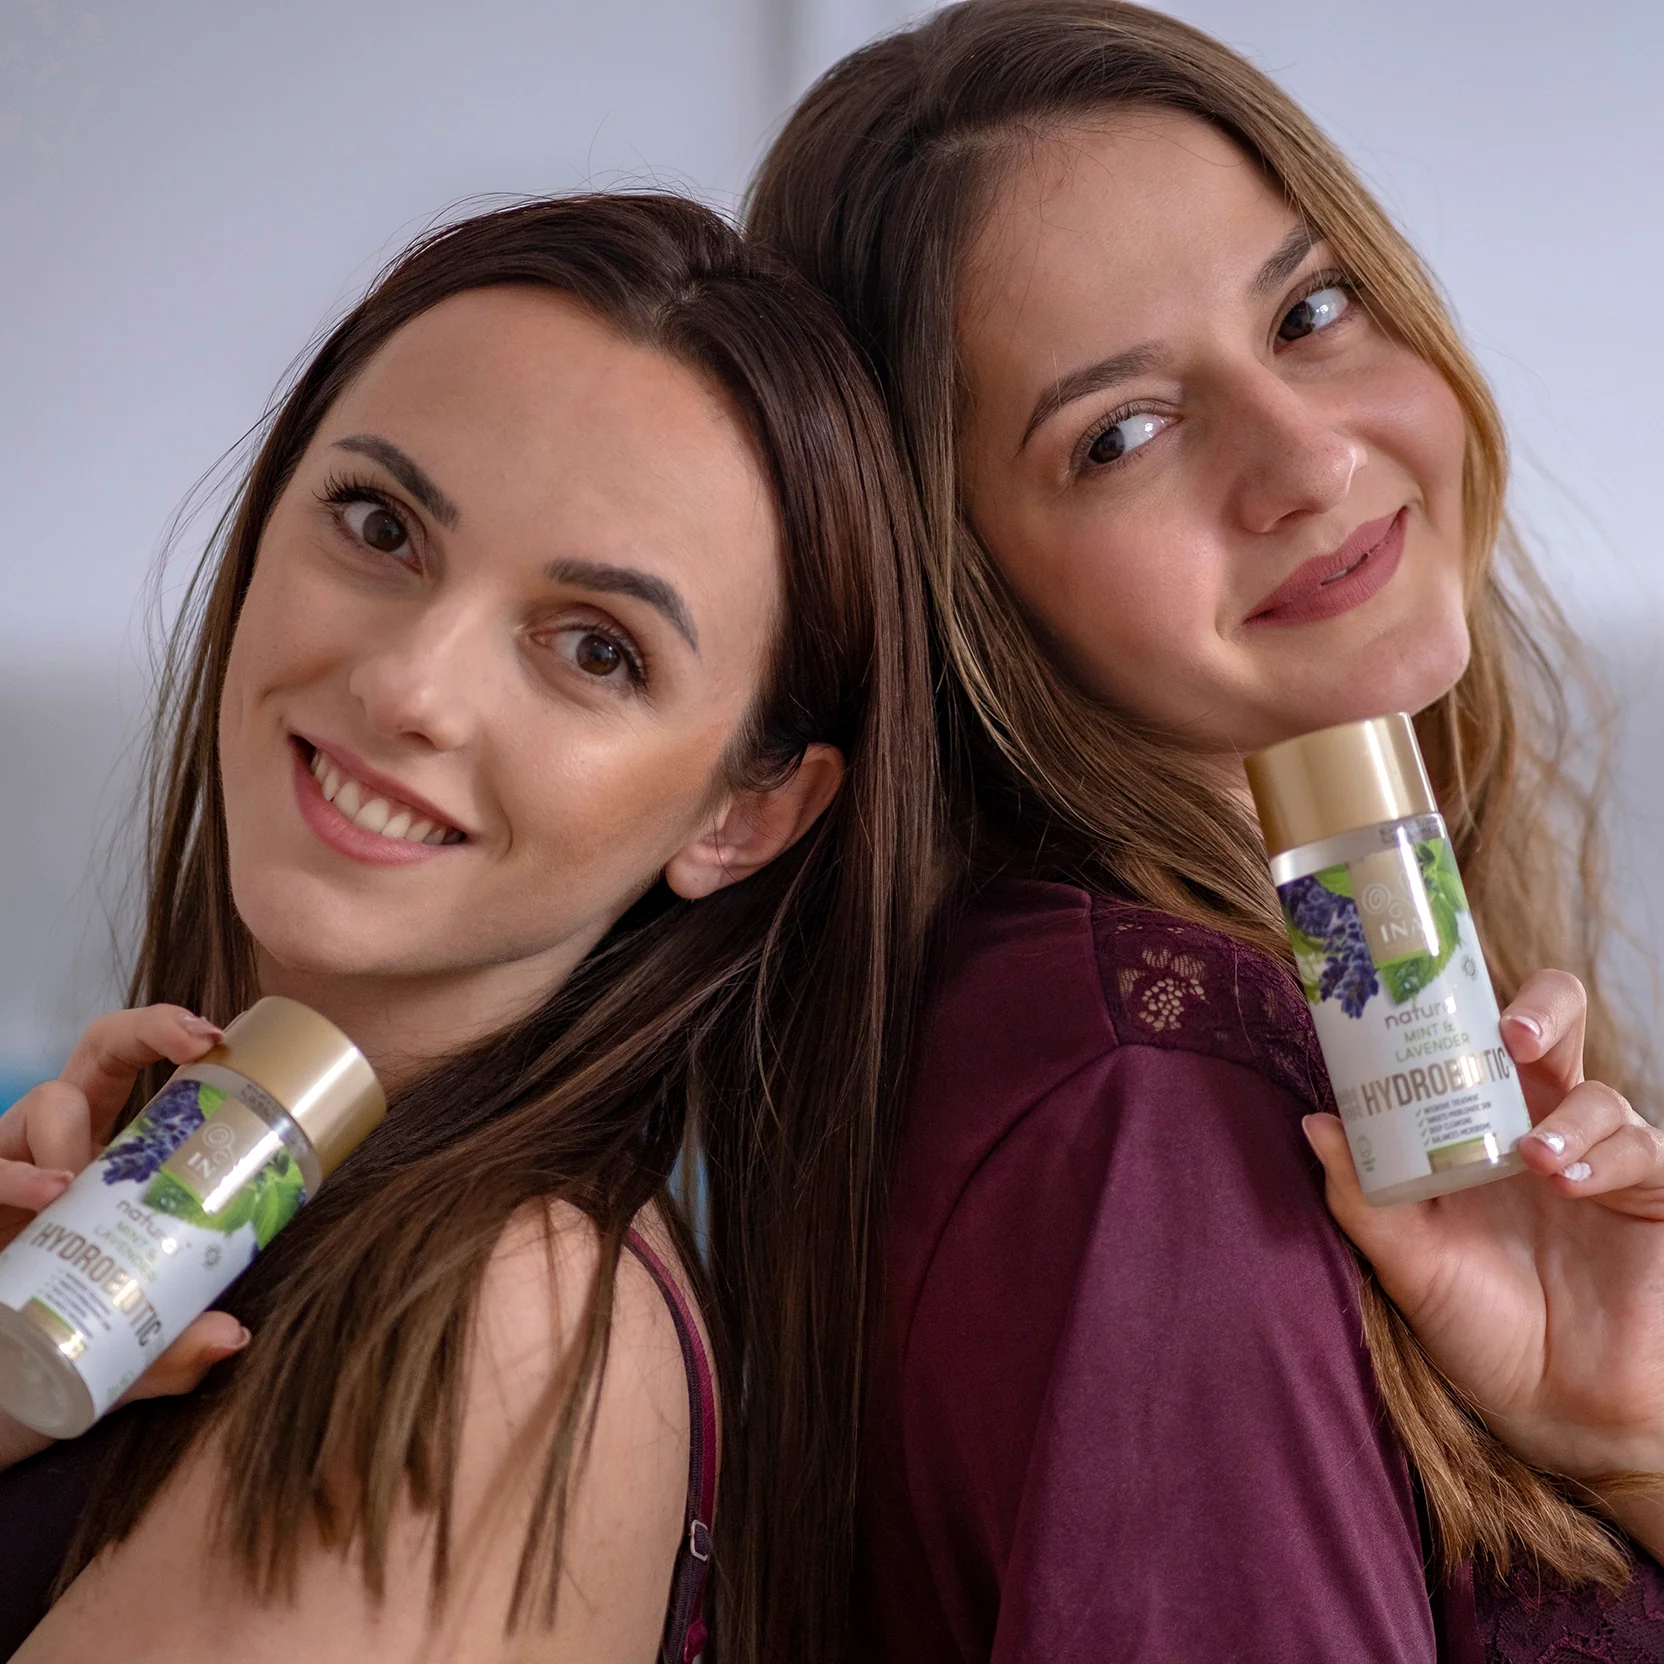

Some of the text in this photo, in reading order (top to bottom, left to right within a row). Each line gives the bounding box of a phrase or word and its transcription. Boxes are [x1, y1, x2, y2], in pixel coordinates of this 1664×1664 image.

[1403, 1020, 1455, 1043] MINT &
[1395, 1032, 1470, 1063] LAVENDER
